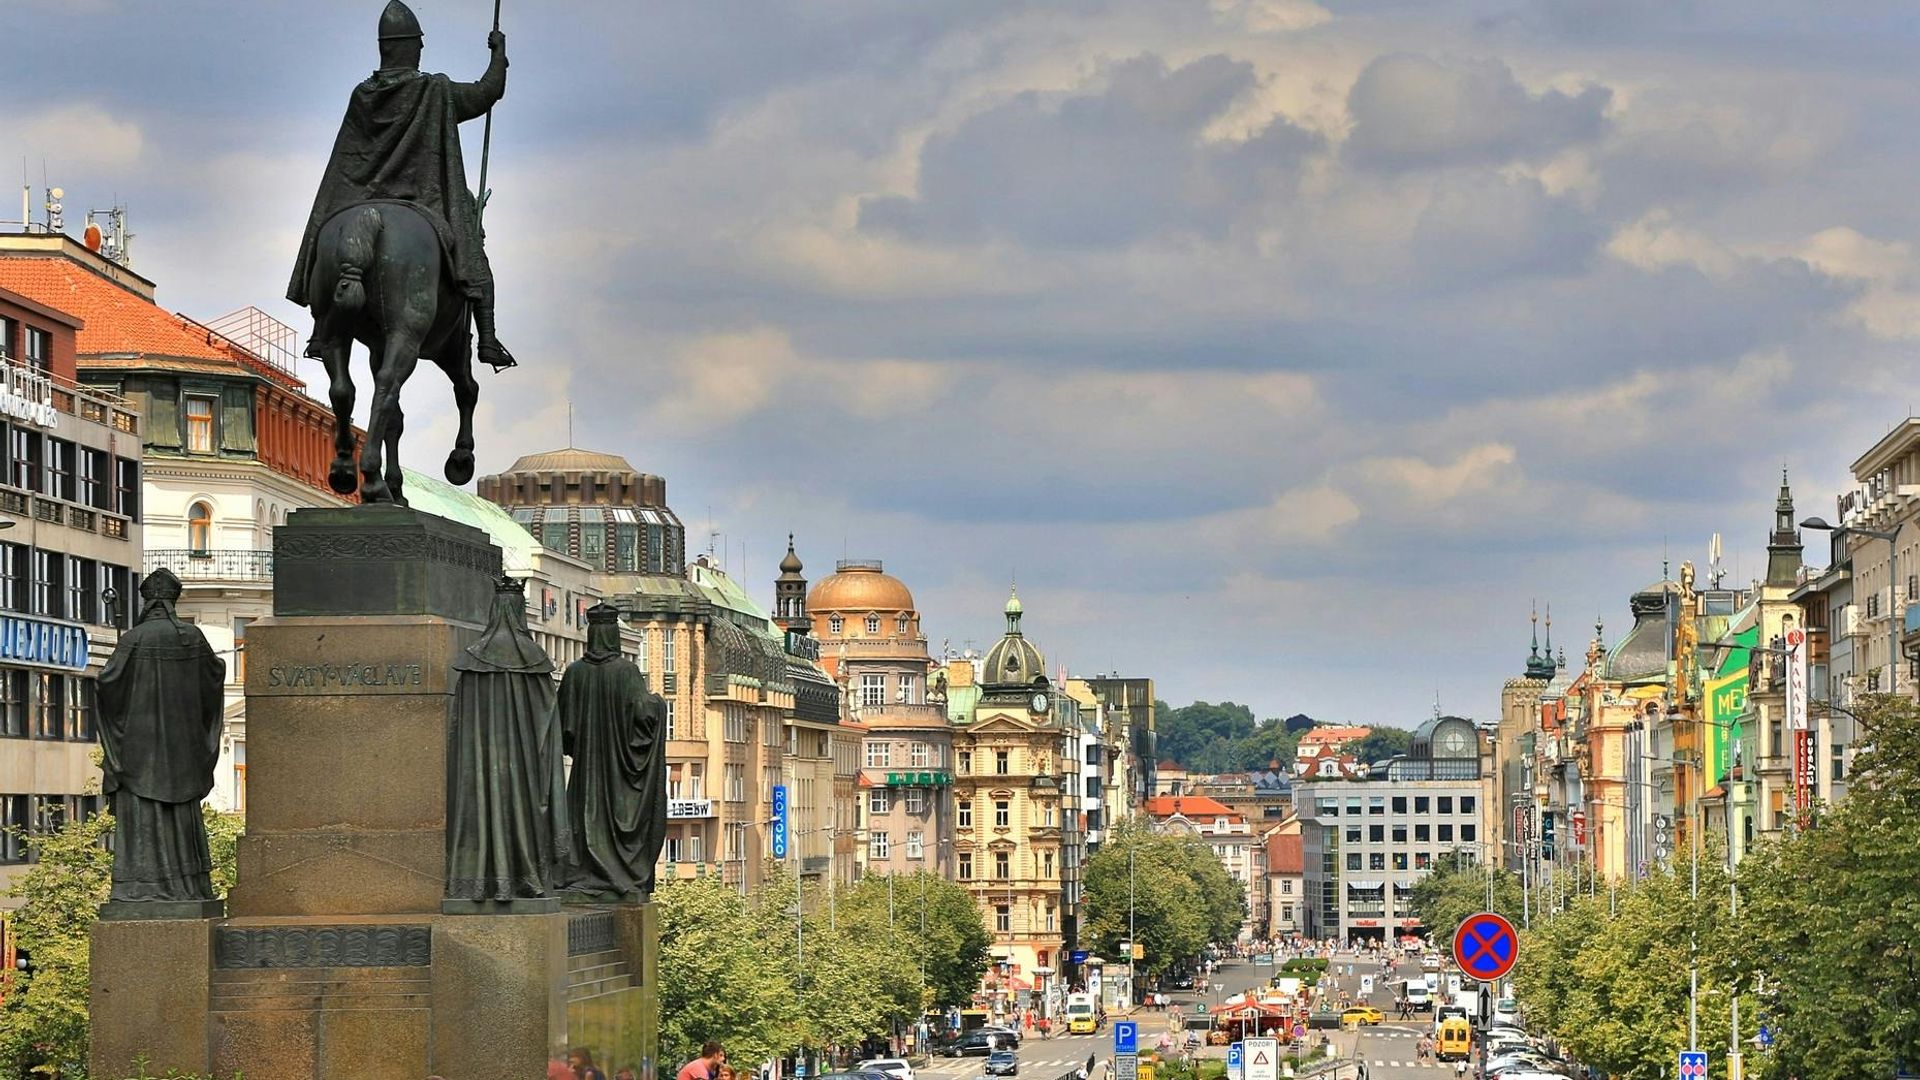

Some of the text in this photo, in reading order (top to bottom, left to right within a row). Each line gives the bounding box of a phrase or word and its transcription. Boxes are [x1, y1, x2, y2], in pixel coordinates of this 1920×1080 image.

[0, 618, 83, 664] JEXPORT
[1791, 654, 1802, 728] RAMADA
[776, 790, 785, 855] ROKOKO
[1119, 1025, 1132, 1044] P
[1231, 1051, 1238, 1063] P
